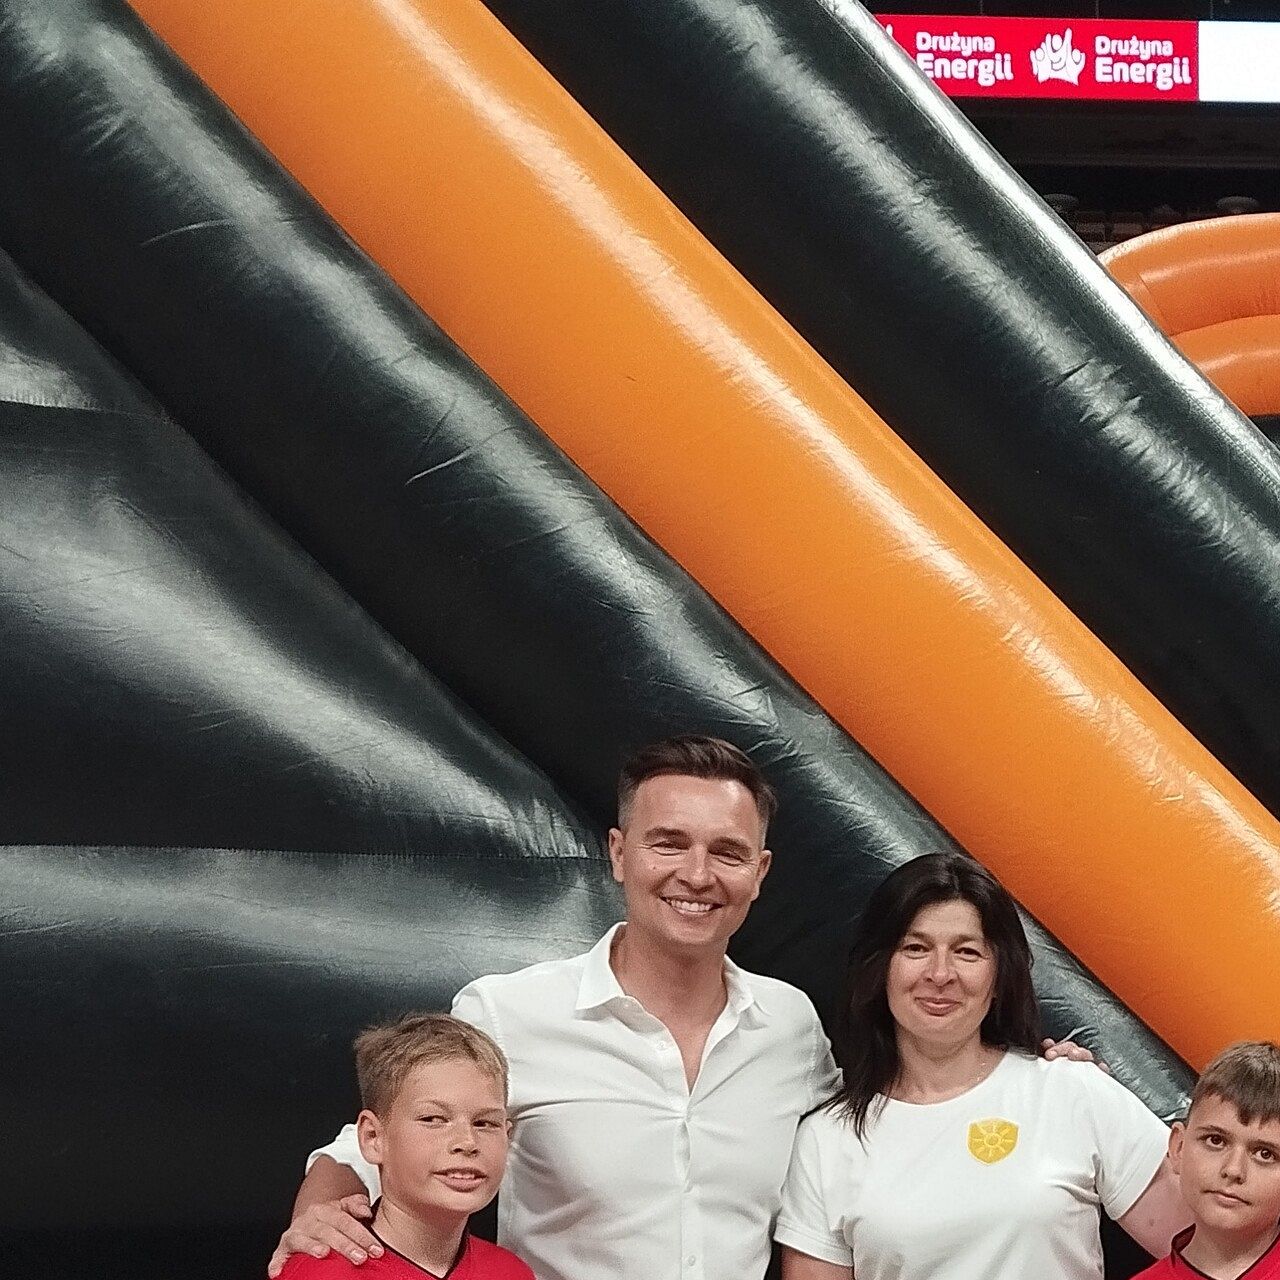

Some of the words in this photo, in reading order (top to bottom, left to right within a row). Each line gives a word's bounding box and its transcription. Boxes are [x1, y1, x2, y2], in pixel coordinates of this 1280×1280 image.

[916, 31, 996, 57] Drużyna
[1095, 35, 1174, 61] Drużyna
[916, 53, 1014, 87] Energii
[1095, 56, 1192, 91] Energii
